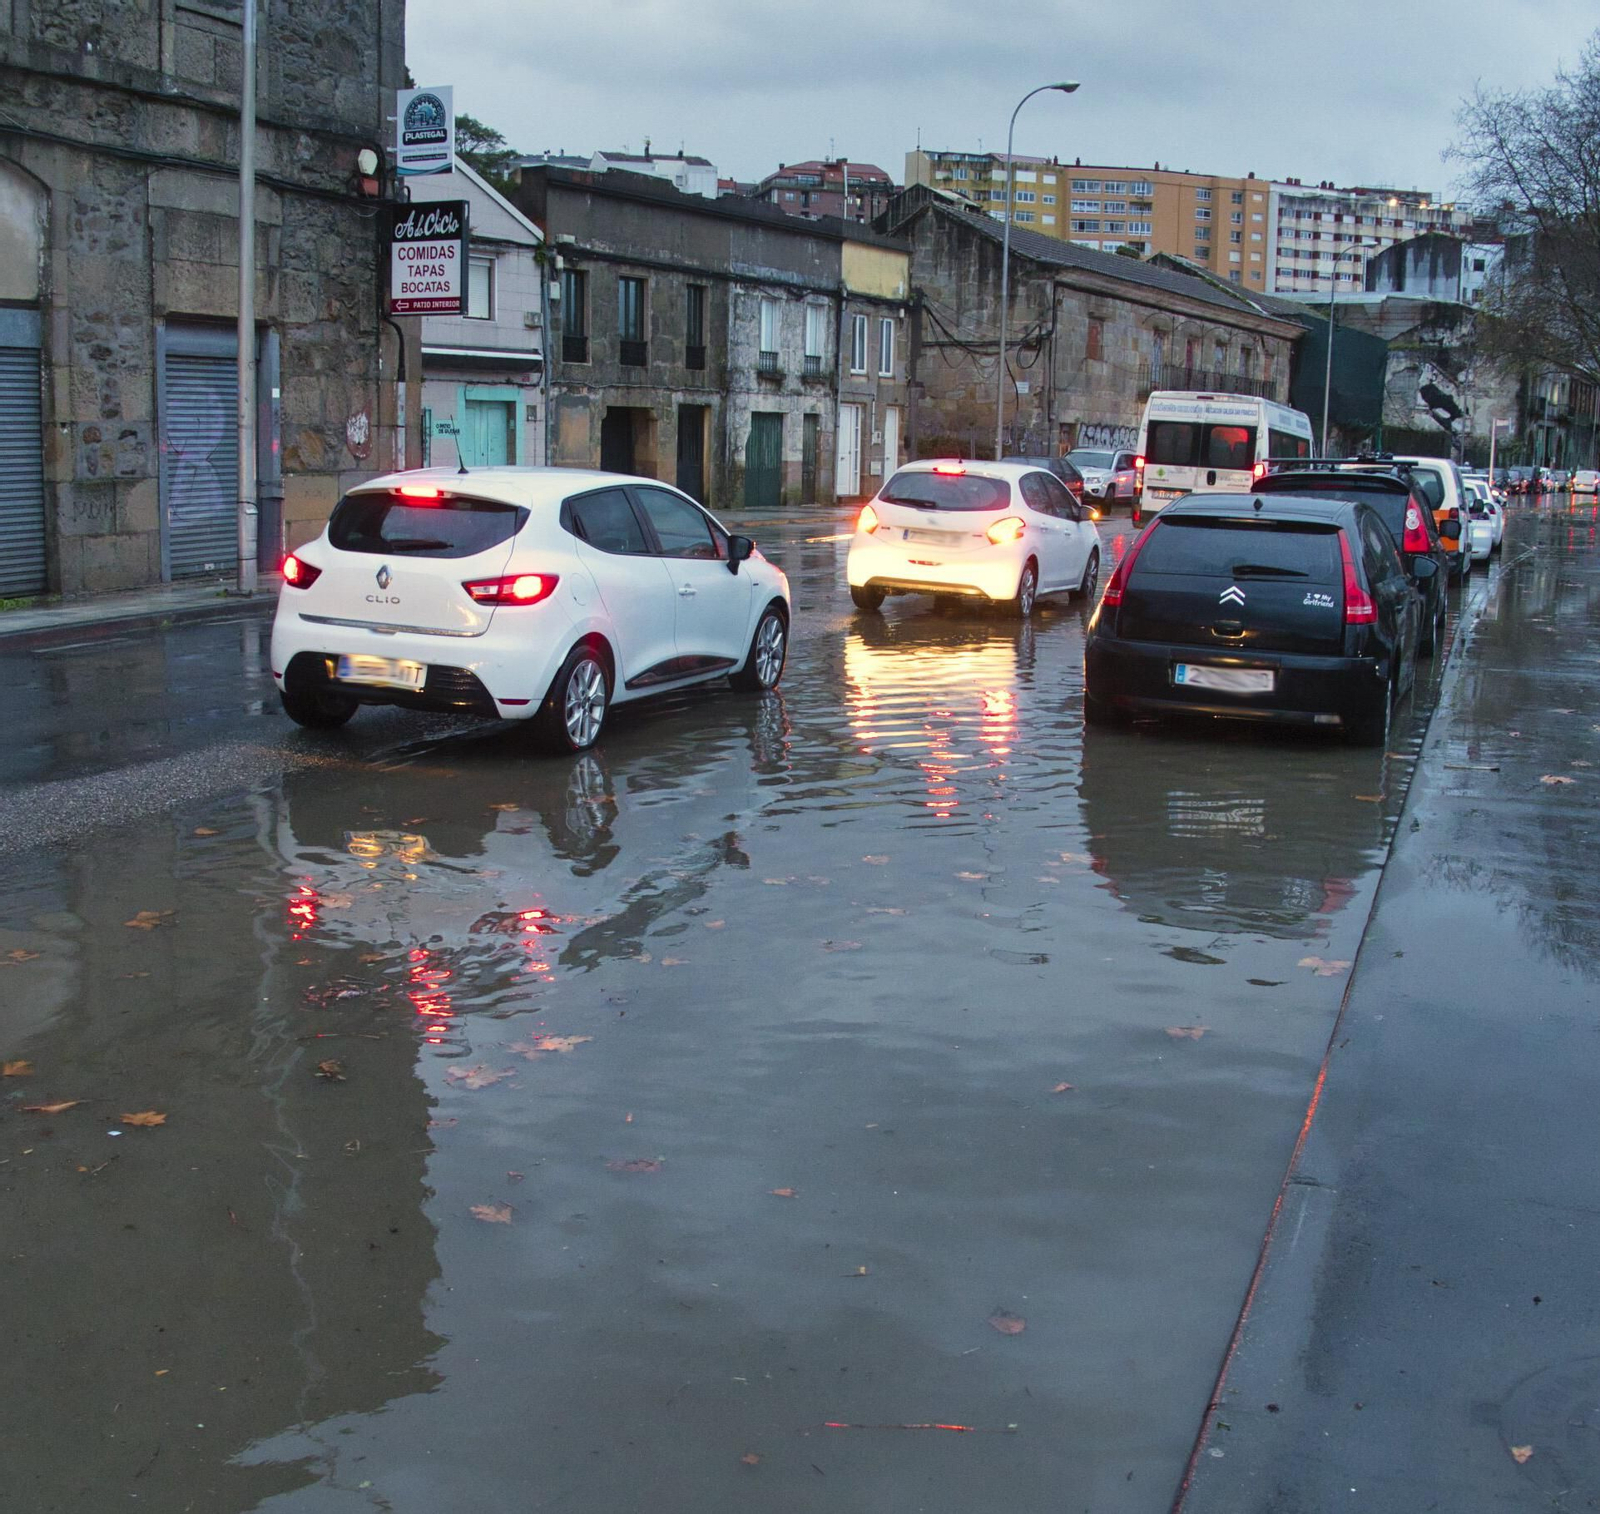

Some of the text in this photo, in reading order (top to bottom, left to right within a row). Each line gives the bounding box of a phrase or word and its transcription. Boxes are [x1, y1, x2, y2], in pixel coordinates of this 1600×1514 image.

[398, 245, 455, 260] COMIDAS
[408, 264, 445, 277] TAPAS
[401, 281, 450, 293] BOCATAS
[366, 595, 400, 604] CLIO
[1303, 598, 1334, 608] Girlfriend
